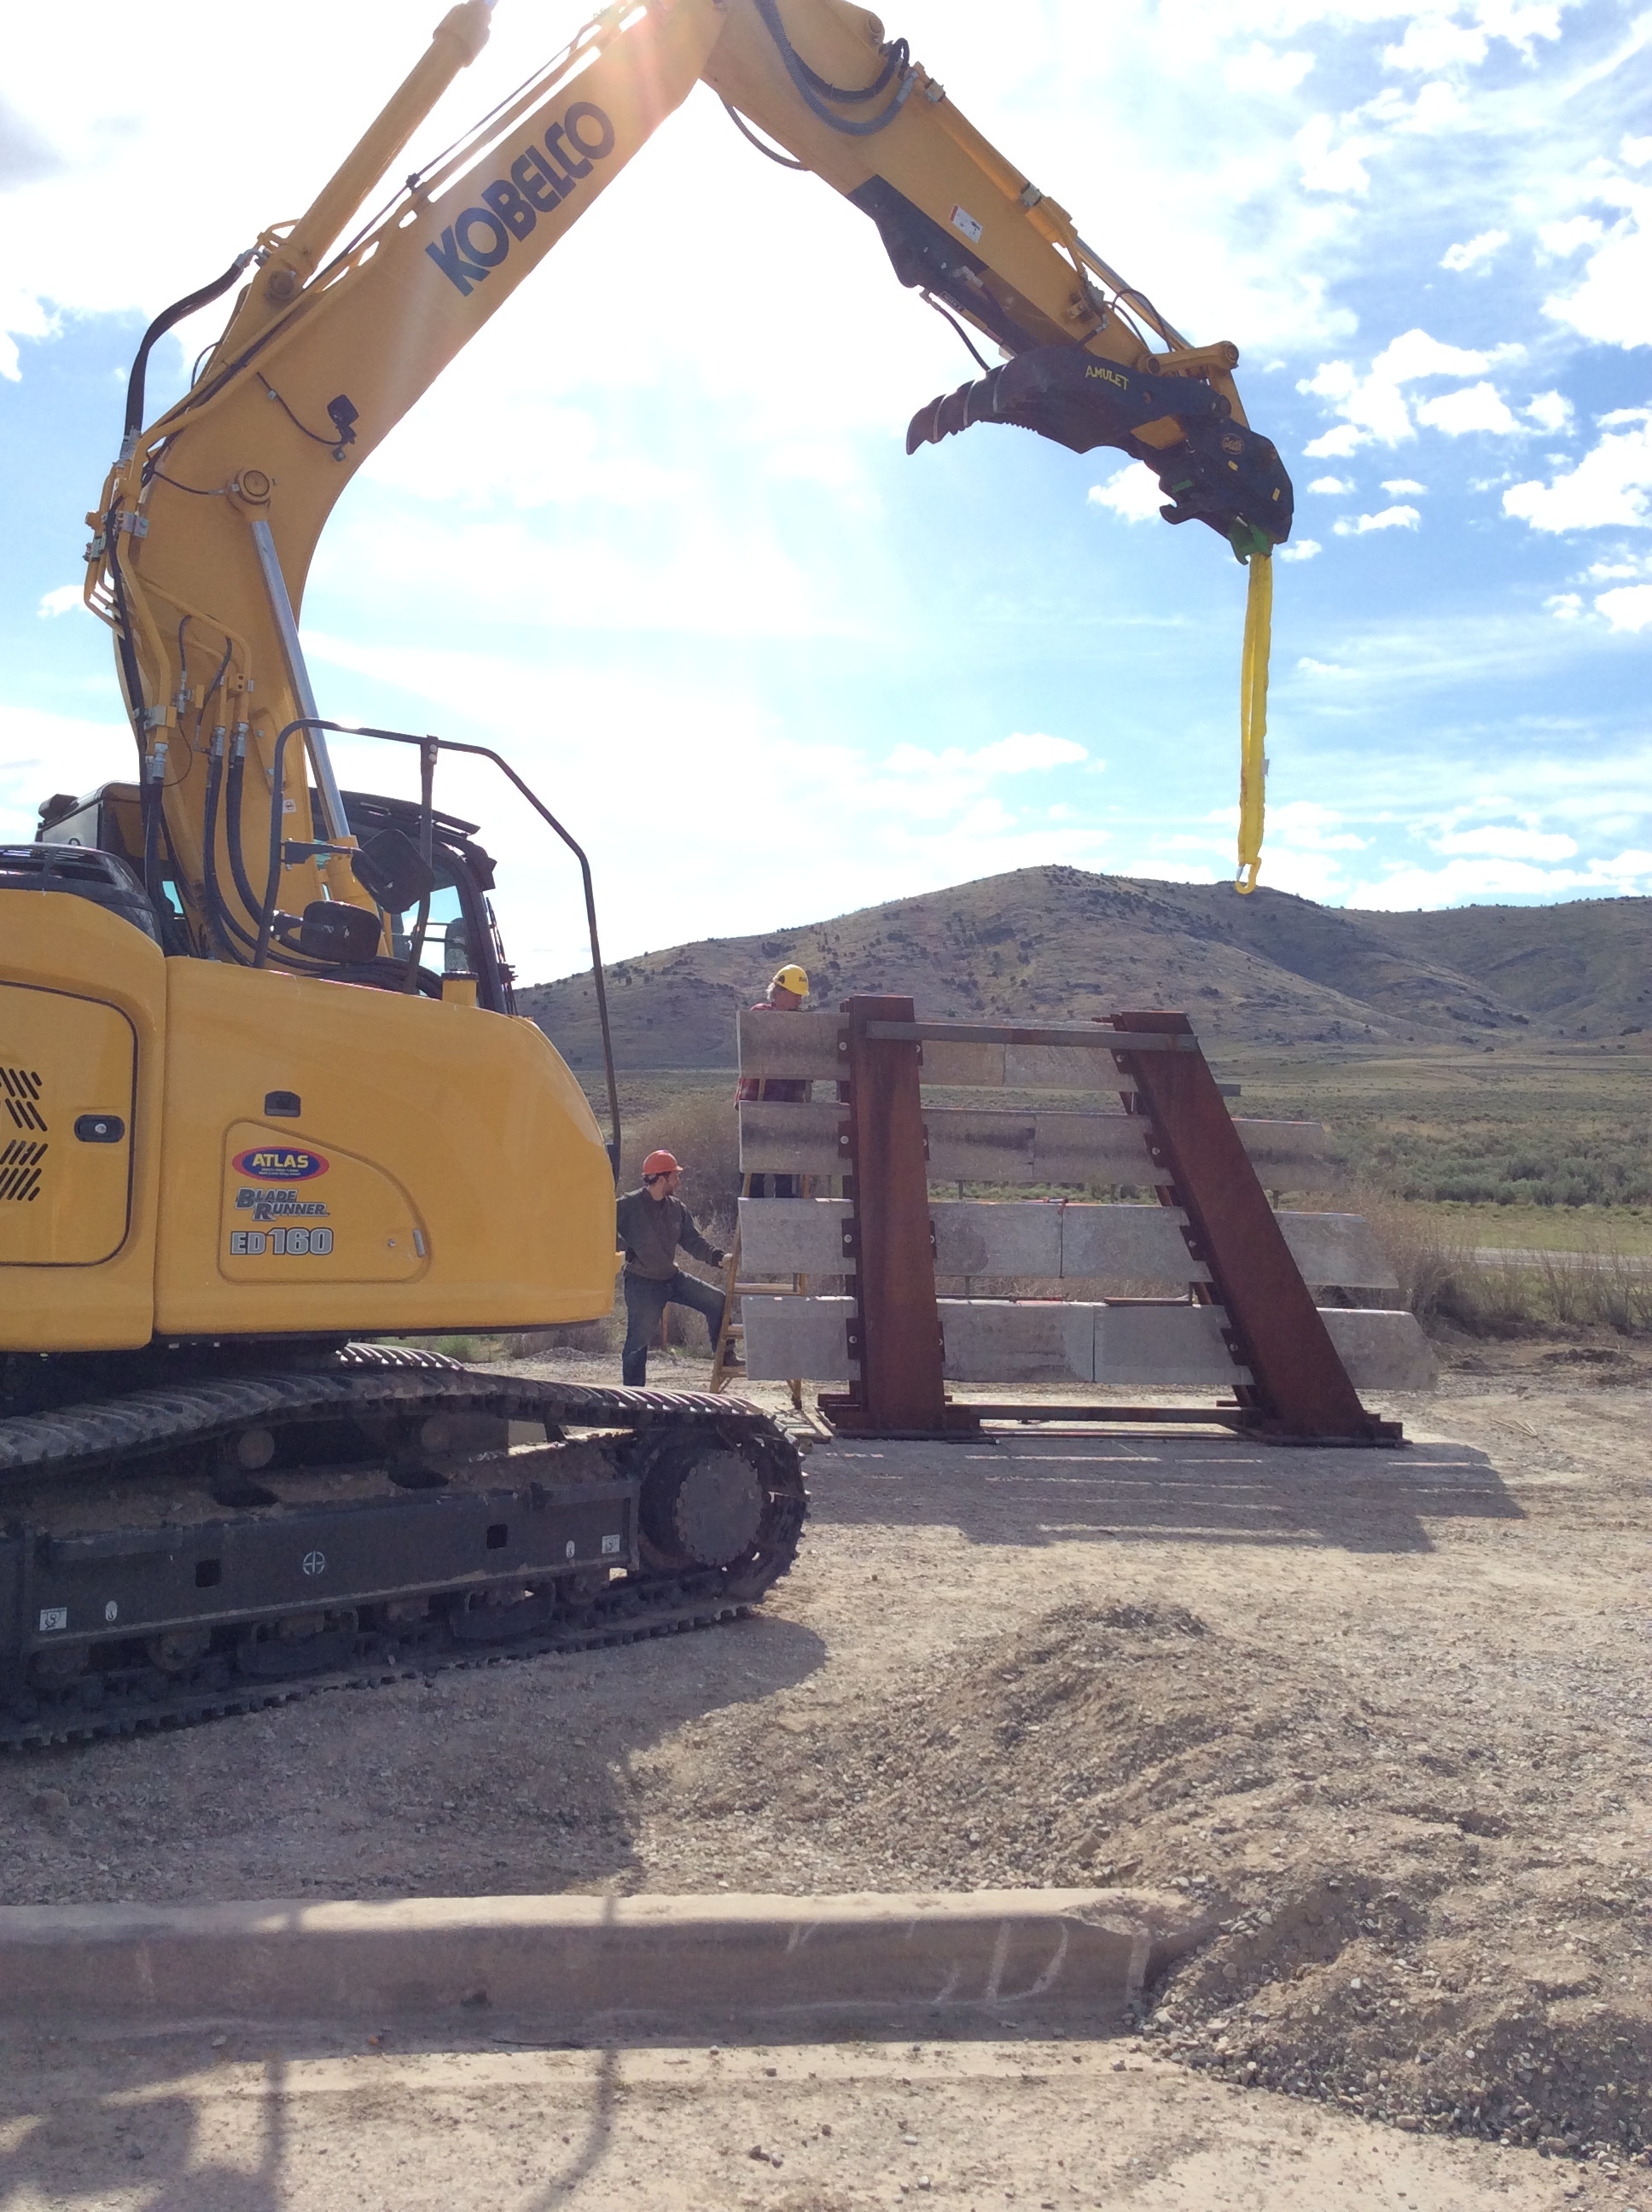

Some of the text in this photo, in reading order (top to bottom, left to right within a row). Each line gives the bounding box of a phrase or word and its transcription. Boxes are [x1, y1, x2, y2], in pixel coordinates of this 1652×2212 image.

[425, 101, 615, 297] KOBELCO
[1085, 364, 1130, 391] AMULET
[252, 1153, 309, 1168] ATLAS
[236, 1187, 297, 1208] BLADE
[253, 1202, 329, 1221] RUNNER
